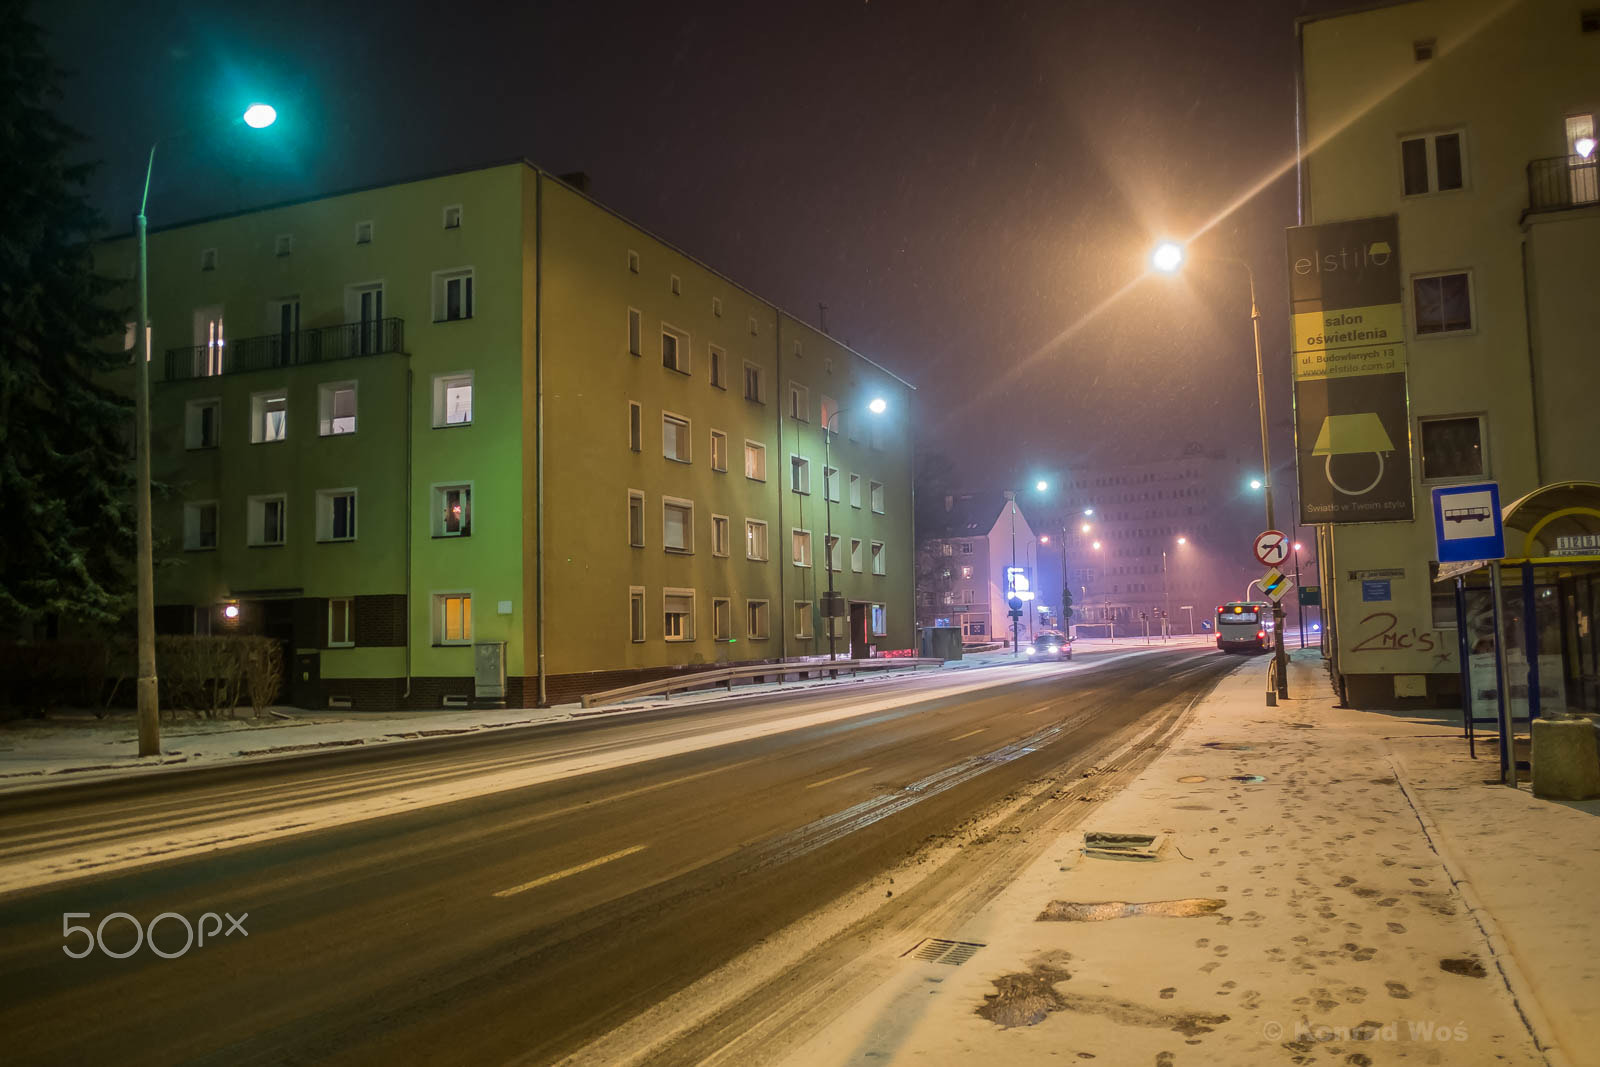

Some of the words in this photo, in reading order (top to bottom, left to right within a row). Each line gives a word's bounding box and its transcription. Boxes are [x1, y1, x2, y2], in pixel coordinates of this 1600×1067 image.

[1325, 314, 1363, 327] salon
[1307, 328, 1388, 345] oświetlenia
[1316, 349, 1380, 363] Budowlanych
